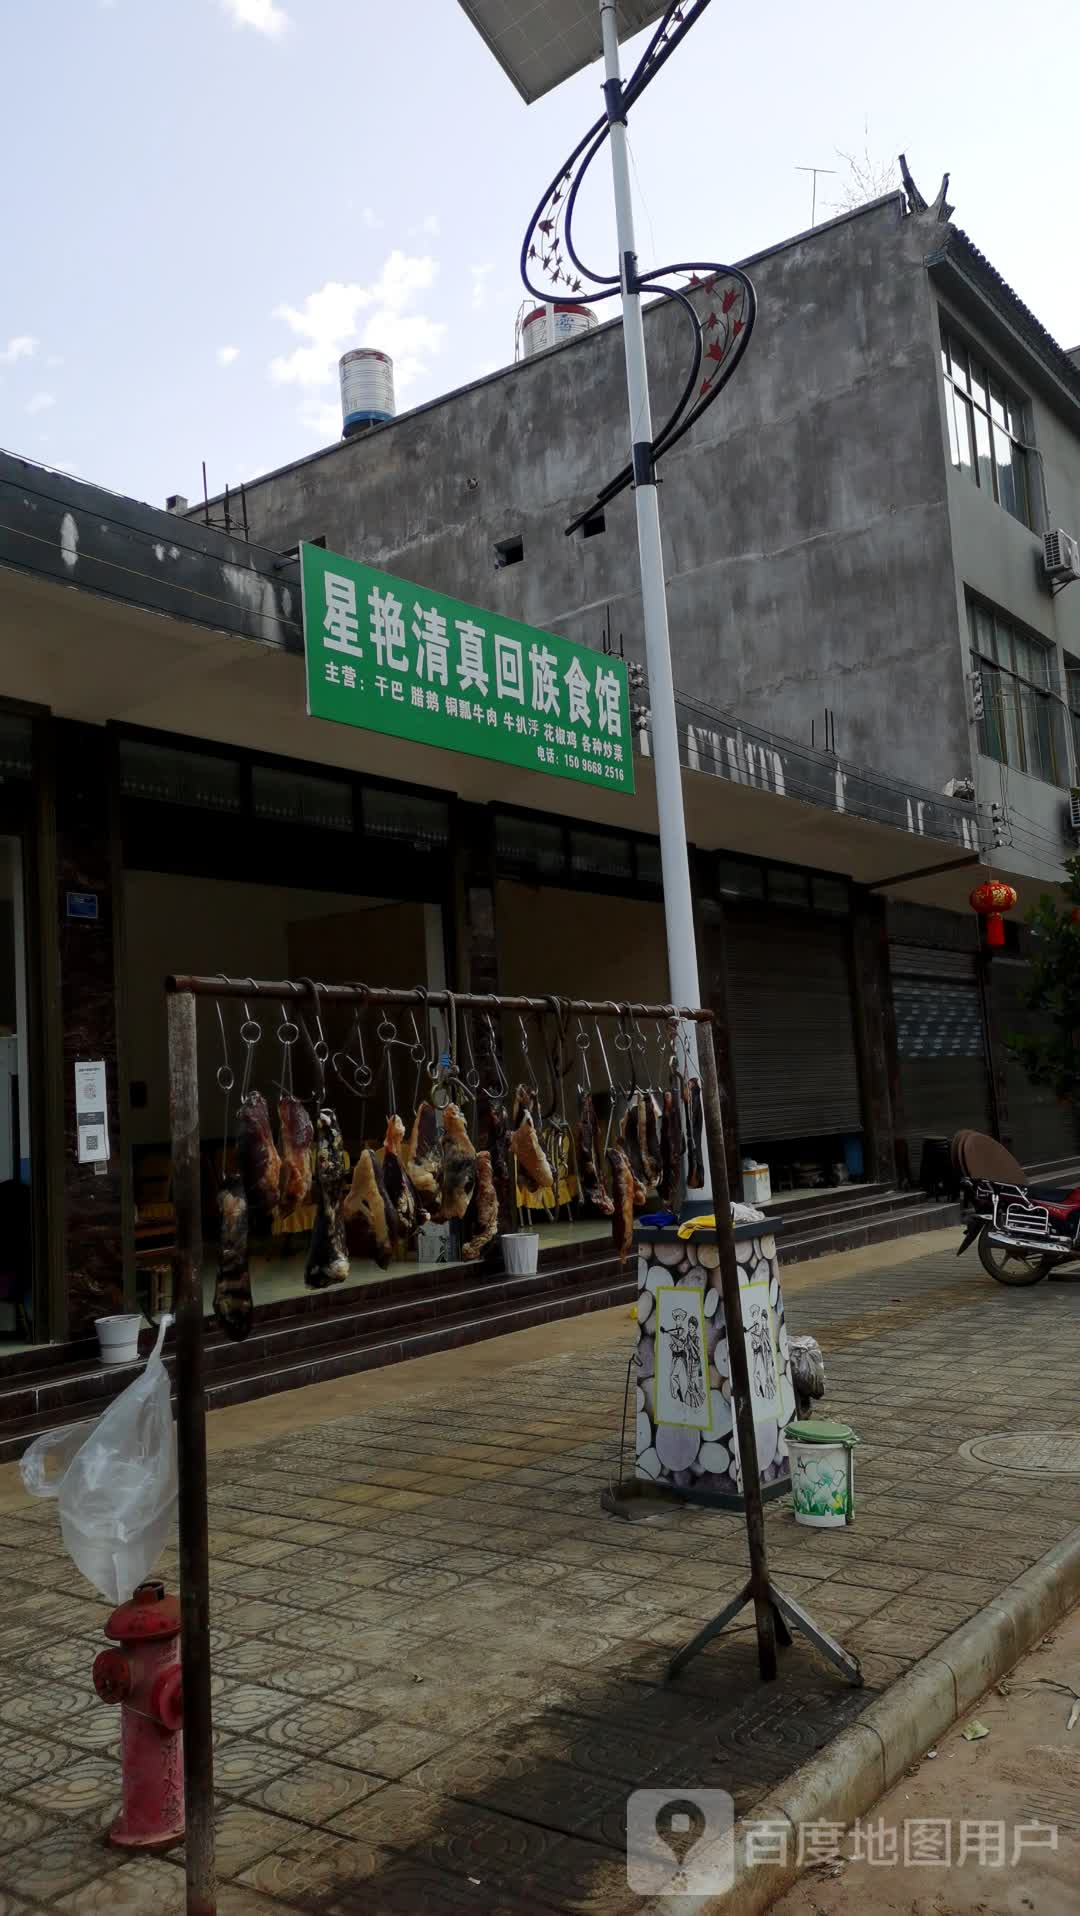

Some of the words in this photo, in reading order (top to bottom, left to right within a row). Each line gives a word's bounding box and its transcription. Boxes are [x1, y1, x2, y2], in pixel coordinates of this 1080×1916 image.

[323, 570, 622, 737] 星艳清真回族食馆
[374, 675, 404, 702] 干巴
[411, 686, 439, 713] 腊鹅
[445, 695, 498, 728] 铜瓢牛肉
[543, 722, 577, 749] 花椒鸡
[581, 734, 624, 762] 各种炒菜
[564, 754, 580, 769] 150
[582, 758, 603, 776] 9668
[604, 765, 624, 781] 2516
